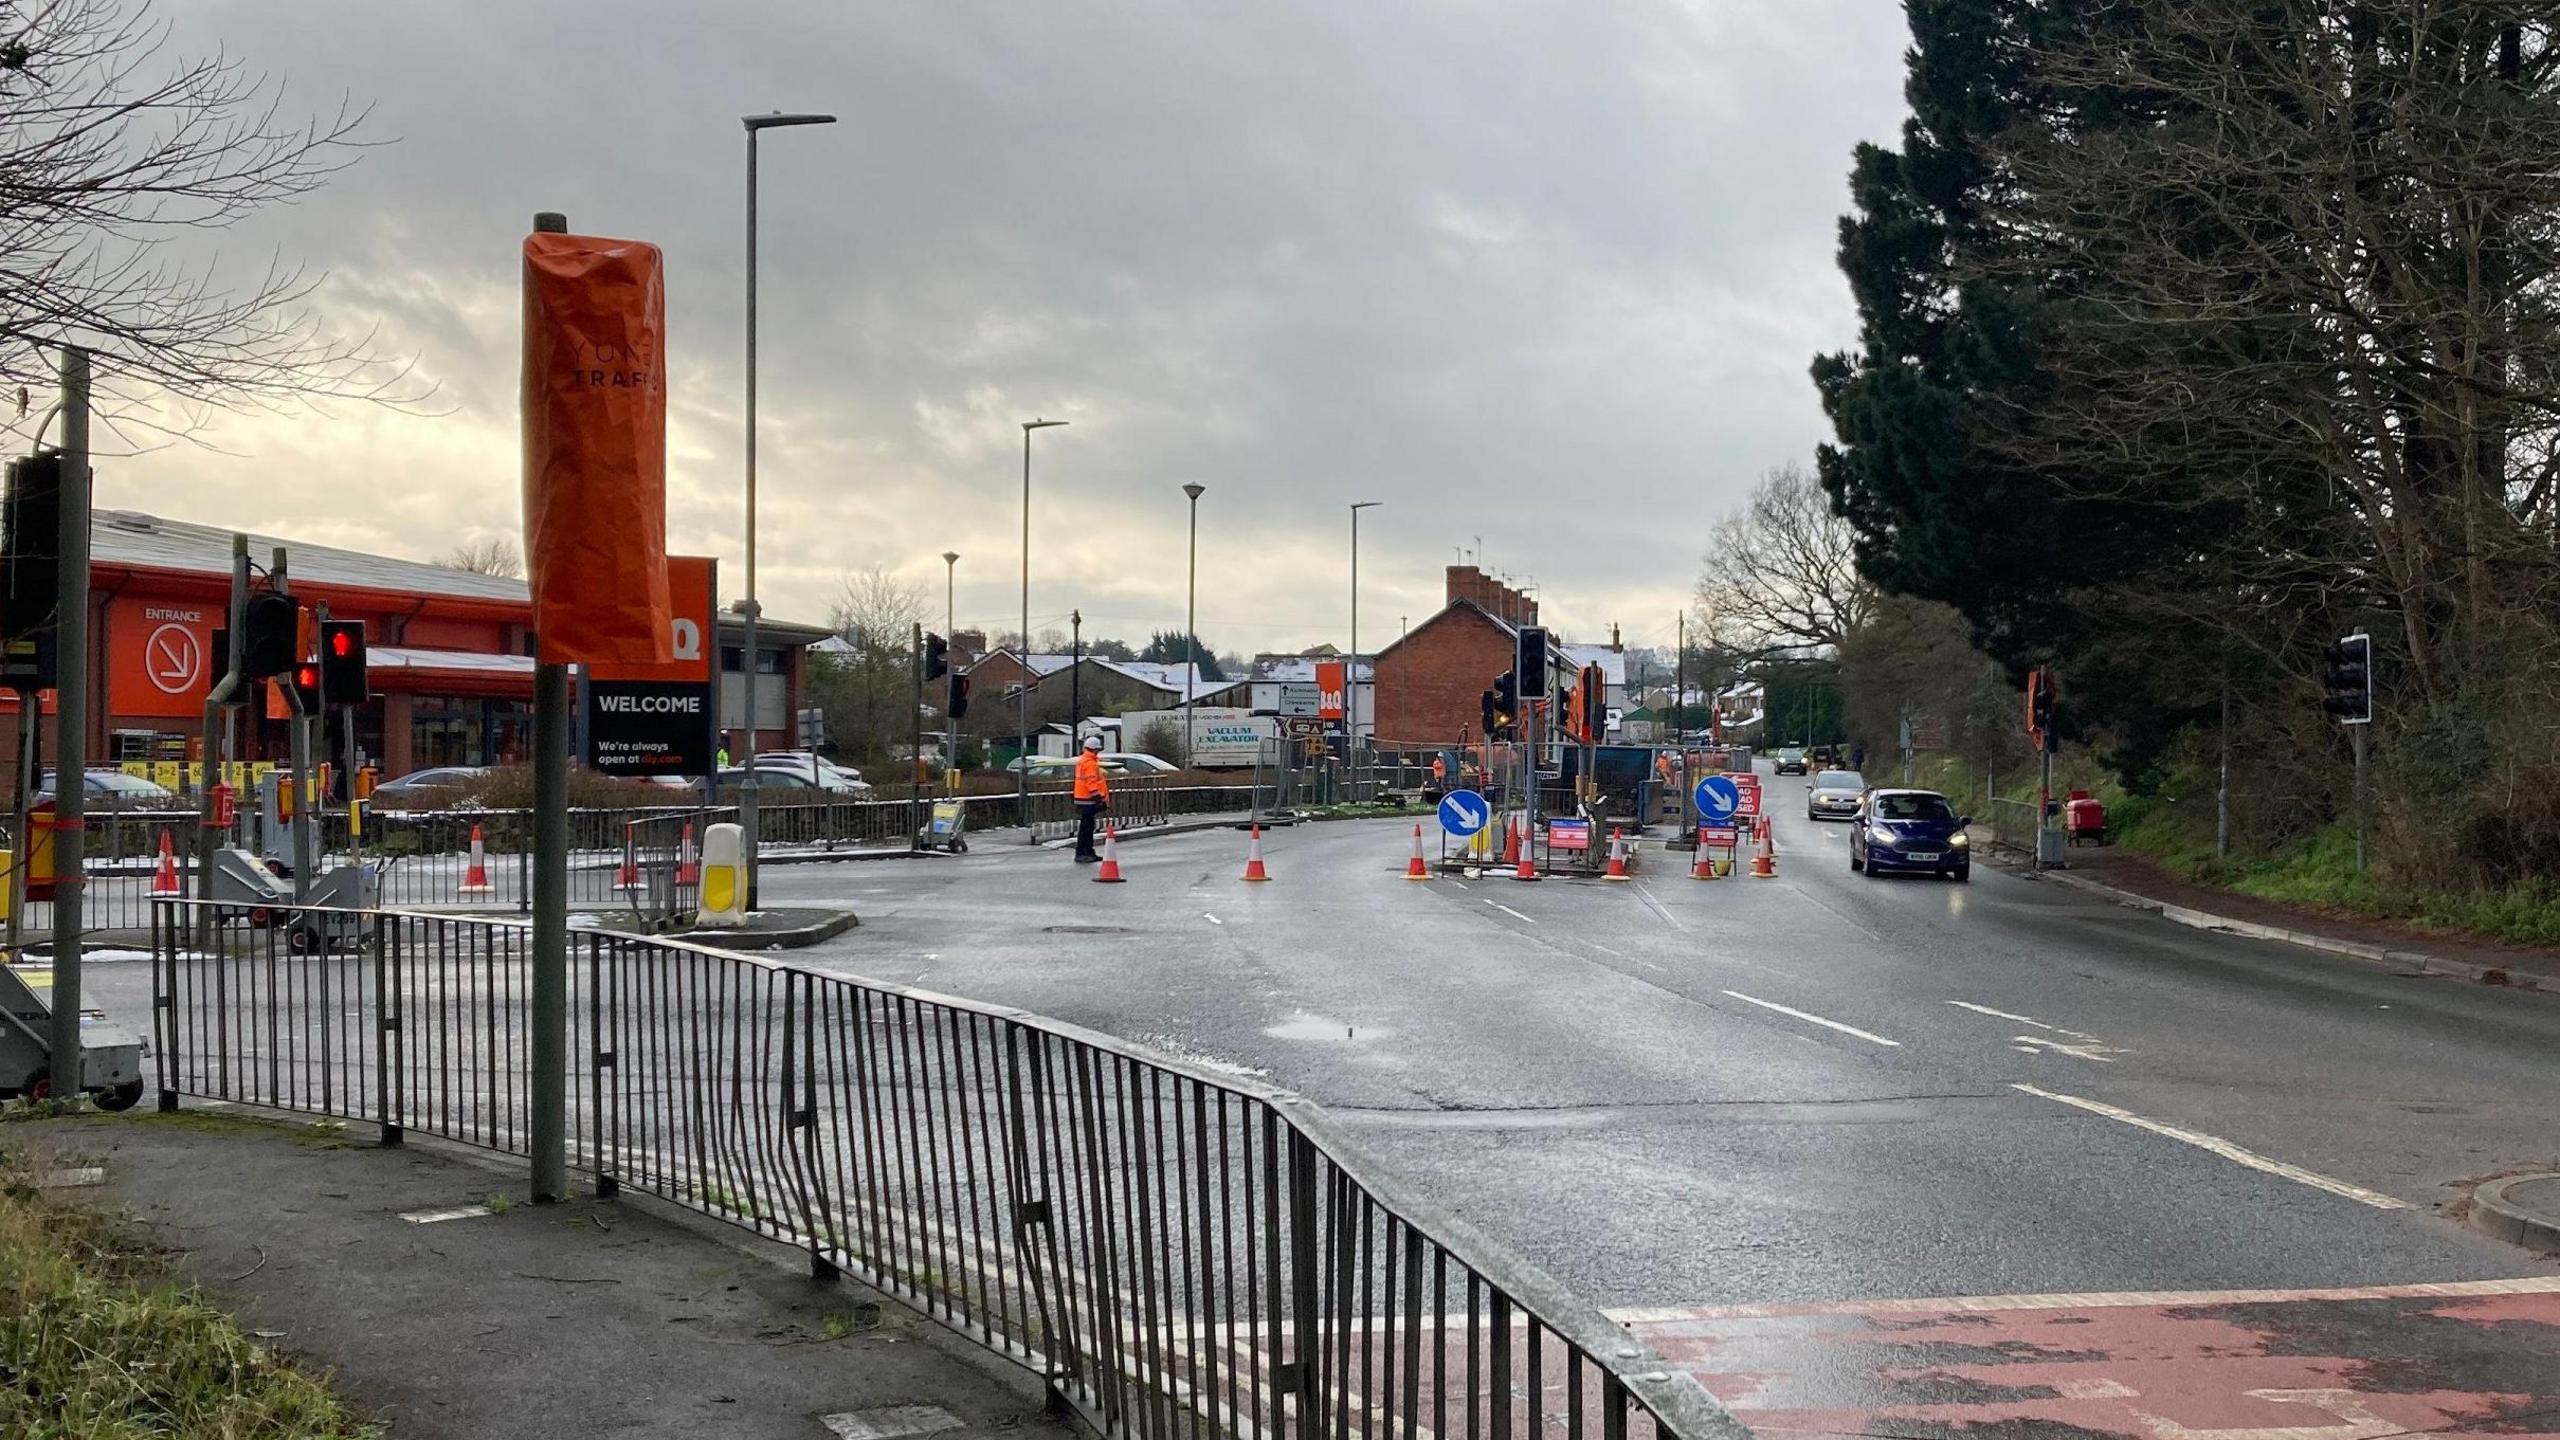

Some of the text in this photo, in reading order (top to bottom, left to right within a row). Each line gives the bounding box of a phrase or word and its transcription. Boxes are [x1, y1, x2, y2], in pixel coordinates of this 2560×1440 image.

[145, 608, 201, 622] ENTRANCE
[599, 696, 700, 713] WELCOME
[1320, 690, 1342, 709] B&Q
[1207, 727, 1252, 735] VACUUM
[1199, 735, 1260, 743] EXCAVATOR
[599, 741, 669, 753] We're always
[598, 754, 683, 766] open at diy.com
